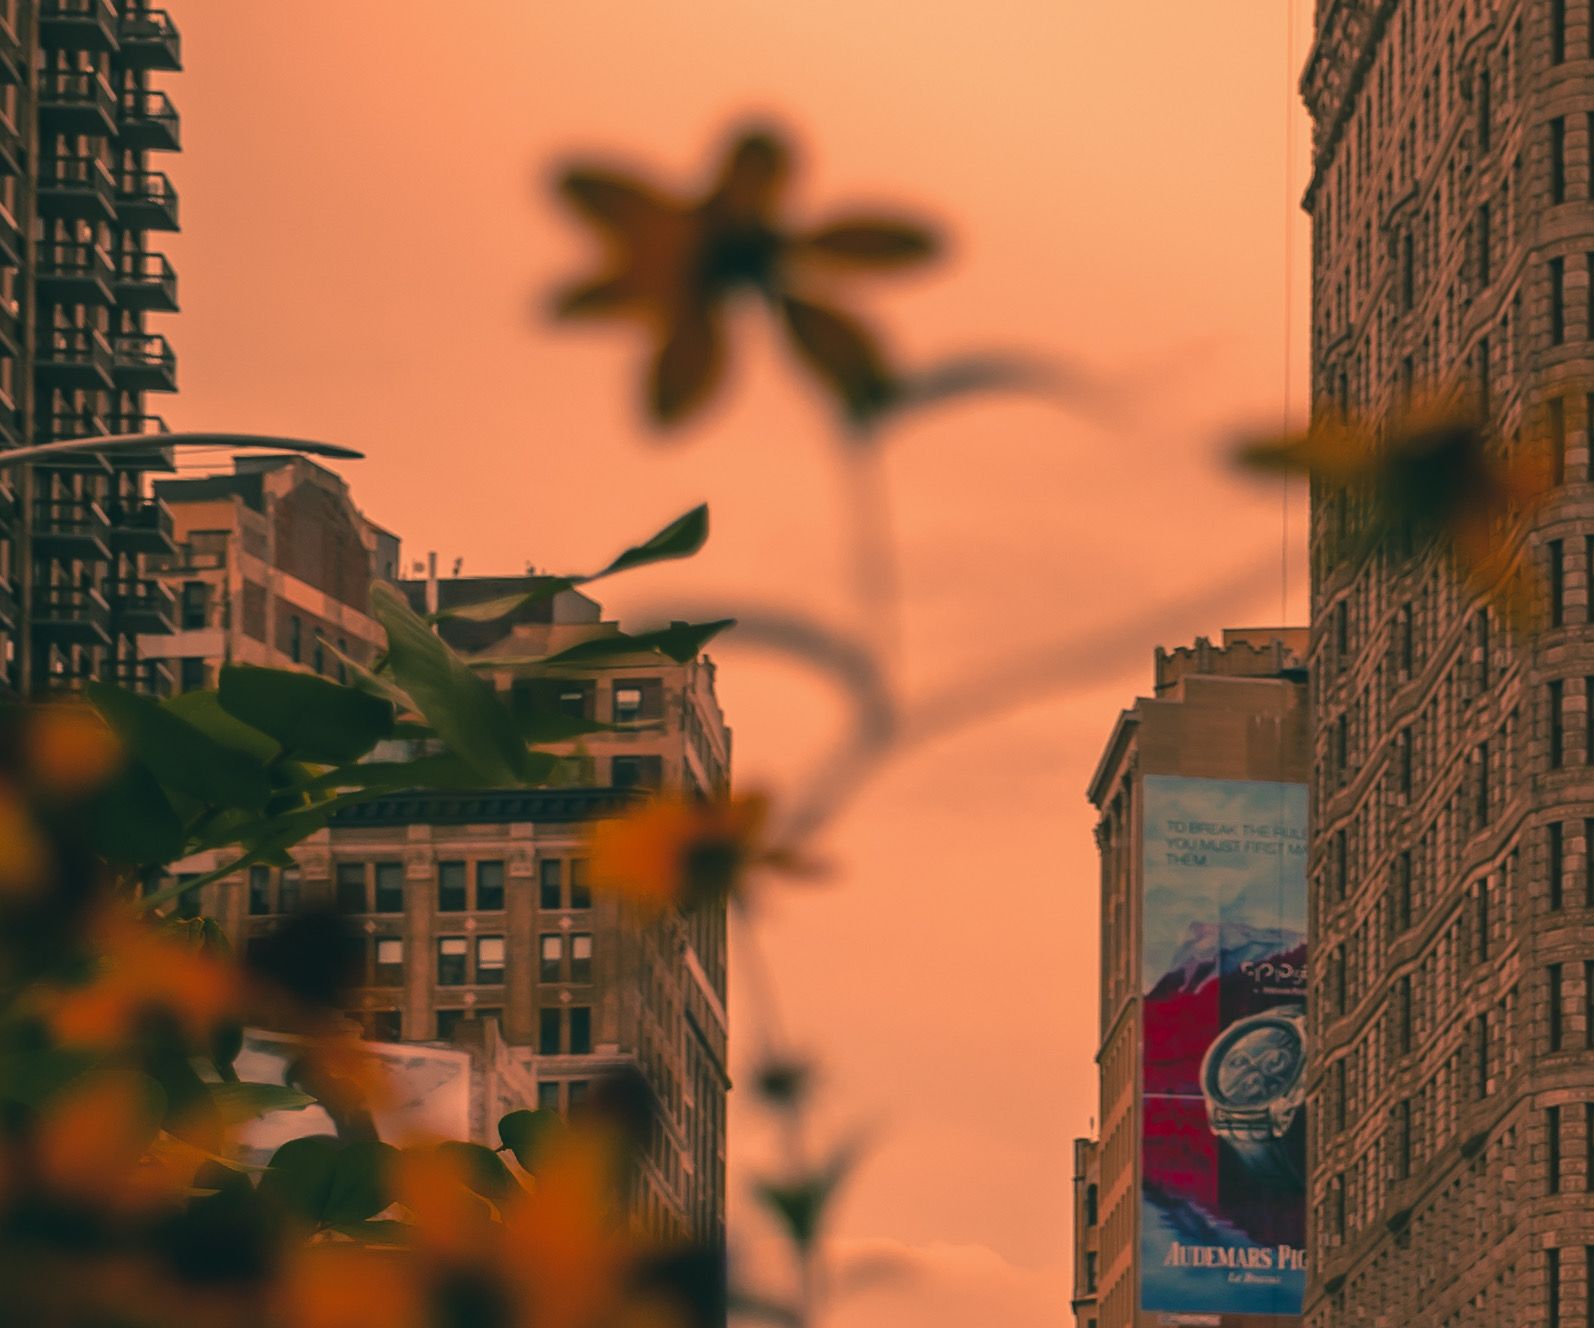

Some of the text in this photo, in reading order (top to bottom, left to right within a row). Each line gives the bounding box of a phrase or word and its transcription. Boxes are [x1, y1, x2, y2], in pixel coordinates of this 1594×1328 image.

[1167, 820, 1186, 833] TO
[1188, 821, 1234, 835] BREAK
[1243, 824, 1269, 837] THE
[1167, 838, 1195, 850] YOU
[1199, 840, 1239, 853] MUST
[1164, 1241, 1272, 1269] AUDEMARS
